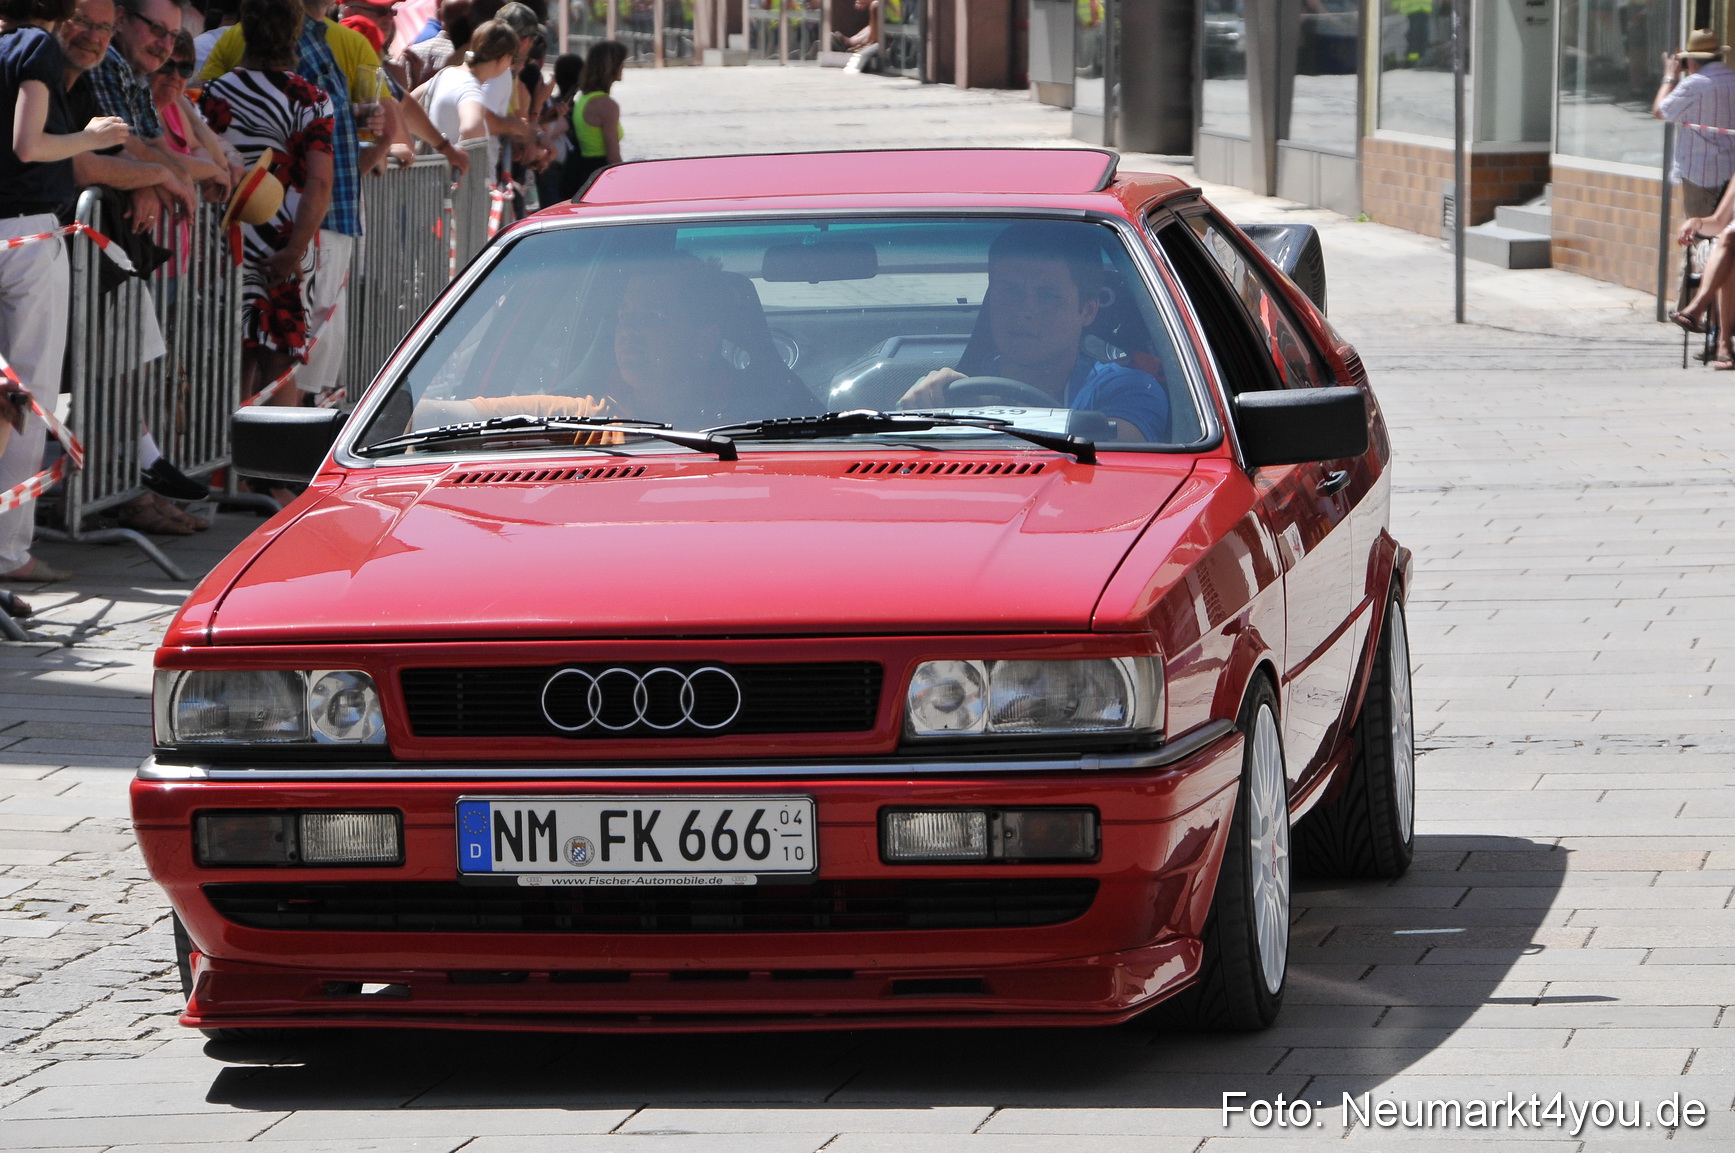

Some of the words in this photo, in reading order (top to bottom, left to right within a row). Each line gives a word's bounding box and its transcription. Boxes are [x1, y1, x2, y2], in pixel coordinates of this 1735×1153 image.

[968, 408, 1027, 416] 539
[779, 810, 803, 825] 04
[494, 809, 558, 862] NM
[600, 809, 664, 862] FK
[678, 808, 771, 861] 666
[470, 843, 482, 859] D
[783, 846, 804, 861] 10
[551, 876, 723, 886] www.Fischer-Automobile.de
